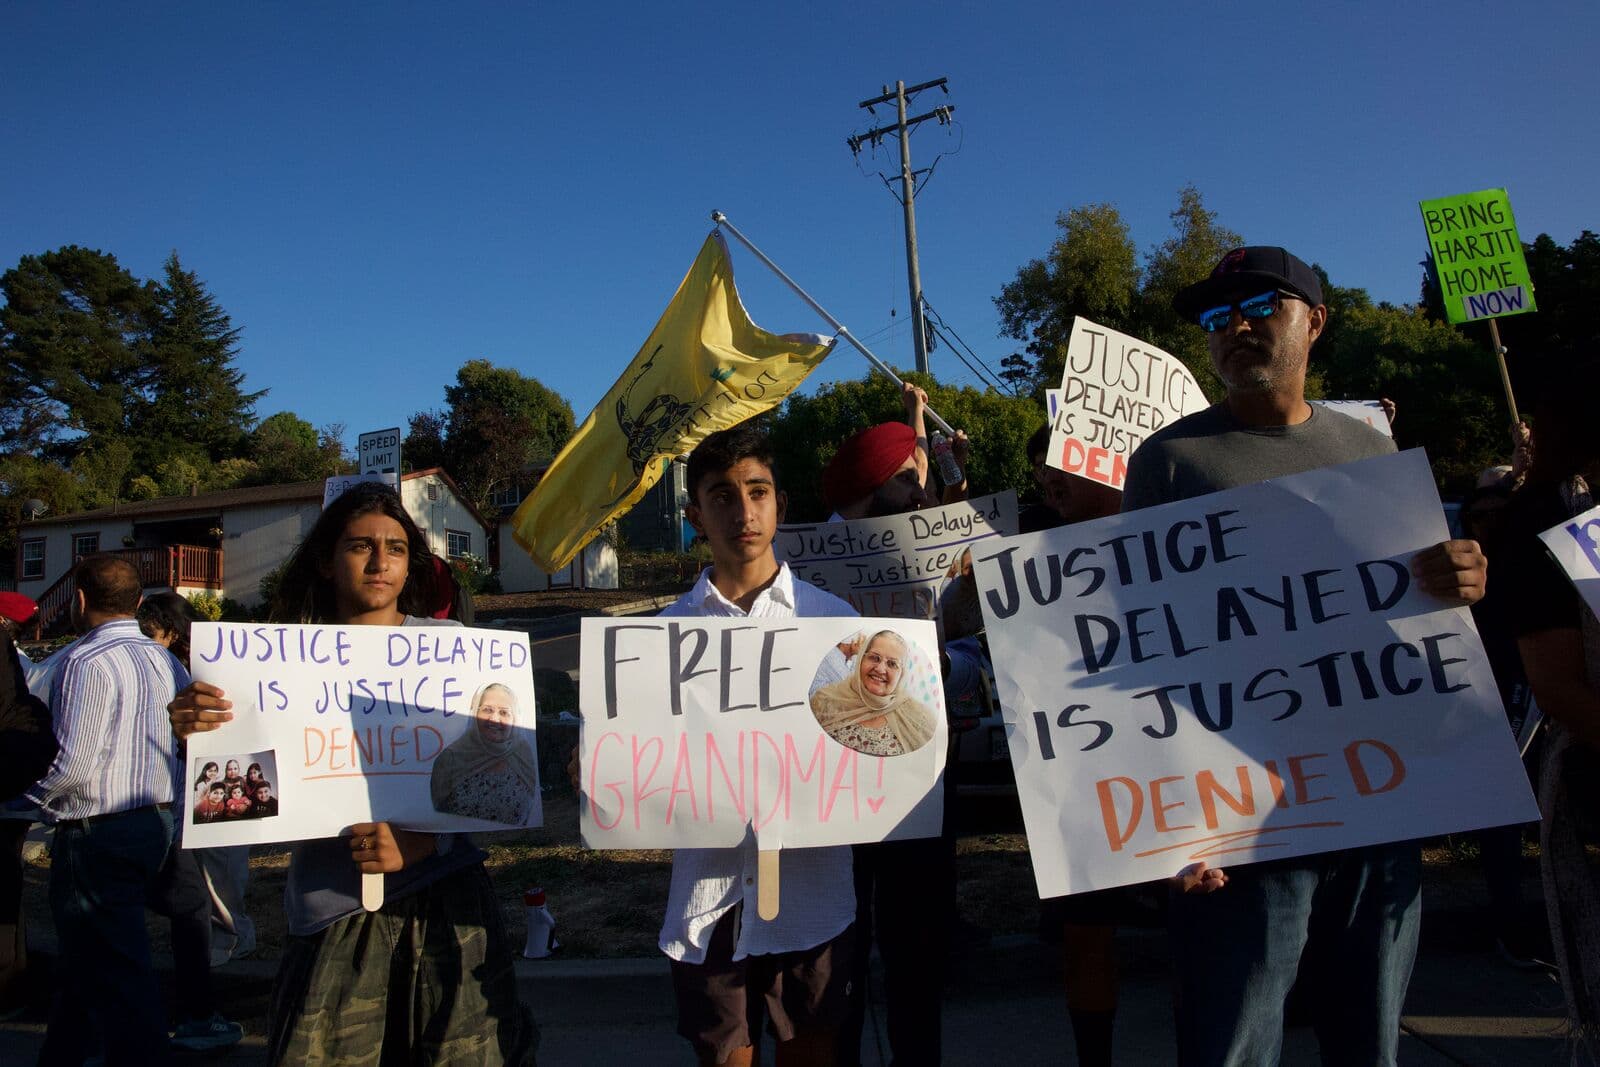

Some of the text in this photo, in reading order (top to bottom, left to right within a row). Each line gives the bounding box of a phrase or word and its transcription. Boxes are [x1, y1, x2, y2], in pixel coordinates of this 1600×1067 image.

[1426, 200, 1504, 234] BRING
[1435, 228, 1516, 264] HARJIT
[1444, 262, 1517, 296] HOME
[1468, 286, 1522, 318] NOW
[1070, 329, 1192, 417] JUSTICE
[1064, 377, 1165, 431] DELAYED
[362, 435, 397, 451] SPEED
[1055, 411, 1144, 455] IS JUST
[366, 452, 393, 467] LIMIT
[1062, 437, 1128, 487] DEN
[777, 498, 1001, 559] Justice Delayed
[790, 552, 951, 586] Is Justice
[979, 510, 1247, 619] JUSTICE
[1074, 559, 1410, 674] DELAYED
[200, 627, 526, 672] JUSTICE DELAYED
[604, 622, 804, 719] FREE
[258, 677, 463, 717] IS JUSTICE
[1033, 704, 1113, 760] IS
[1131, 632, 1472, 739] JUSTICE
[304, 725, 443, 770] DENIED
[1096, 739, 1406, 853] DENIED
